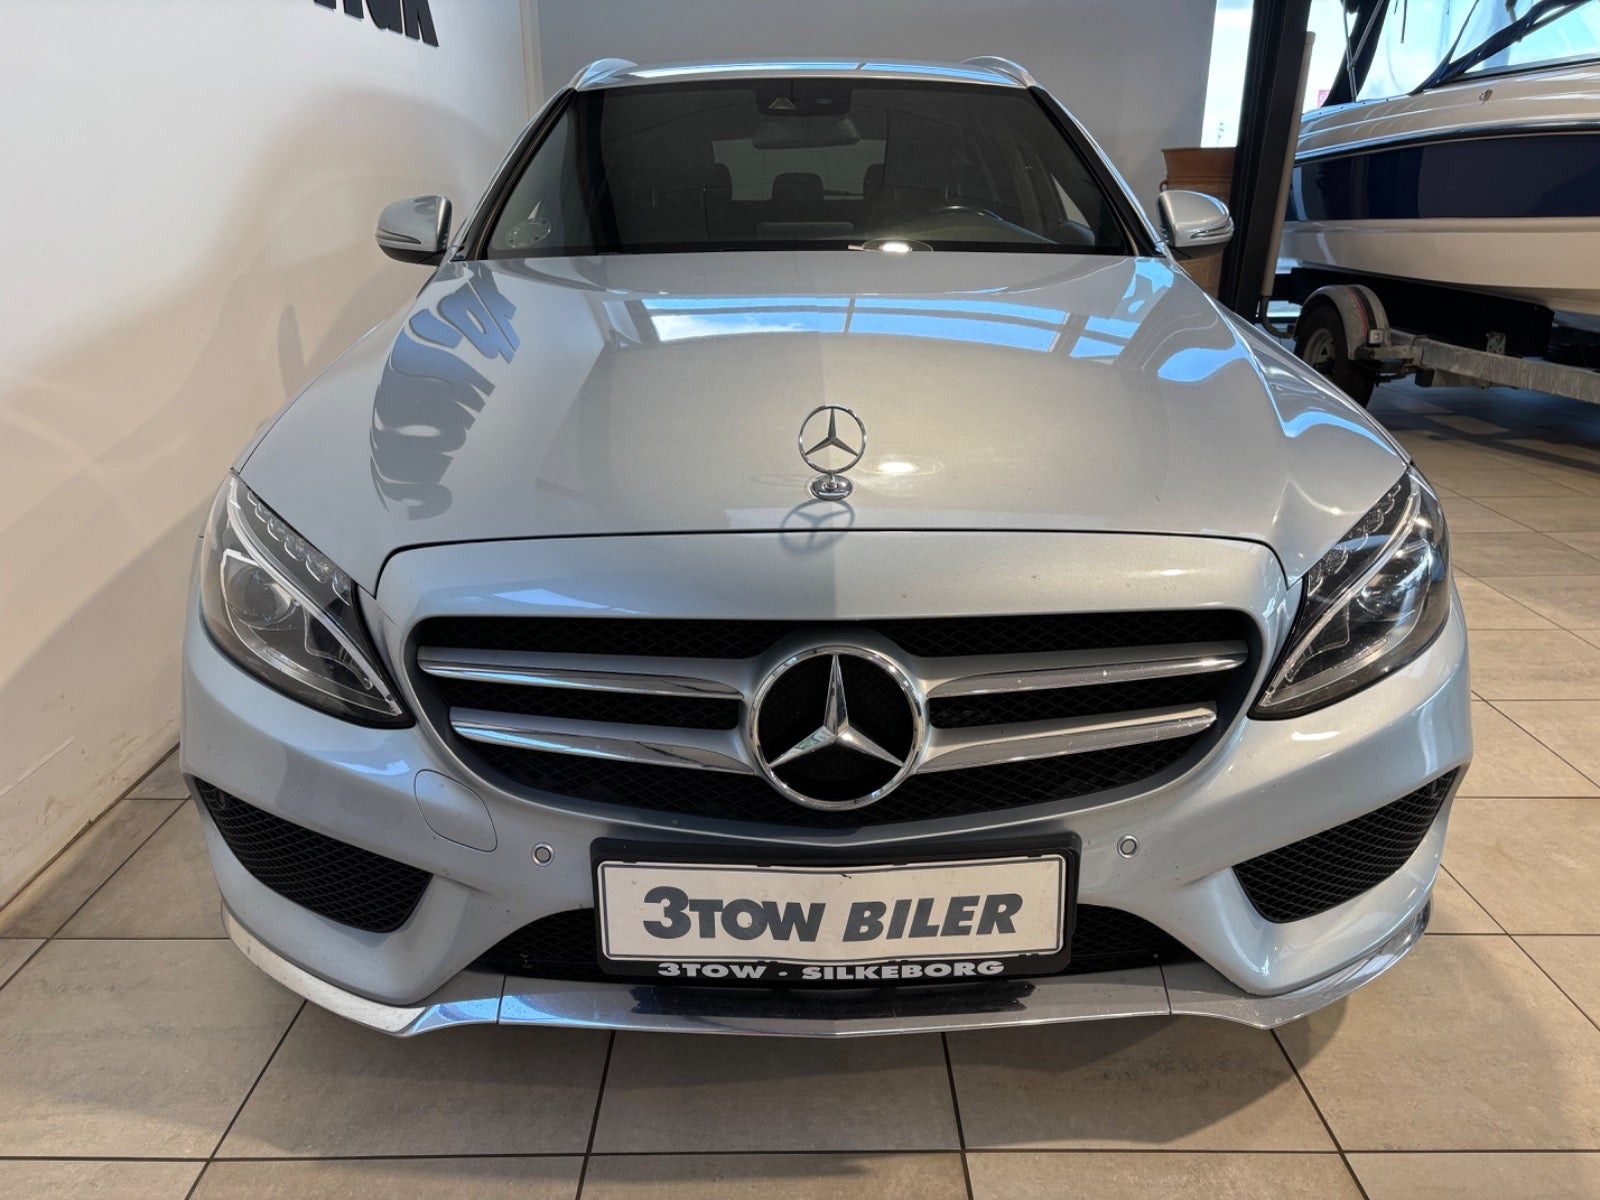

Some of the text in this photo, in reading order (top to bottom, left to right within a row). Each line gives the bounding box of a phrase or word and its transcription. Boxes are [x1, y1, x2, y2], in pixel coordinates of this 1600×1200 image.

[643, 886, 1023, 942] 3TOW BILER
[658, 963, 767, 979] 3TOW
[801, 961, 1004, 980] SILKEBORG
